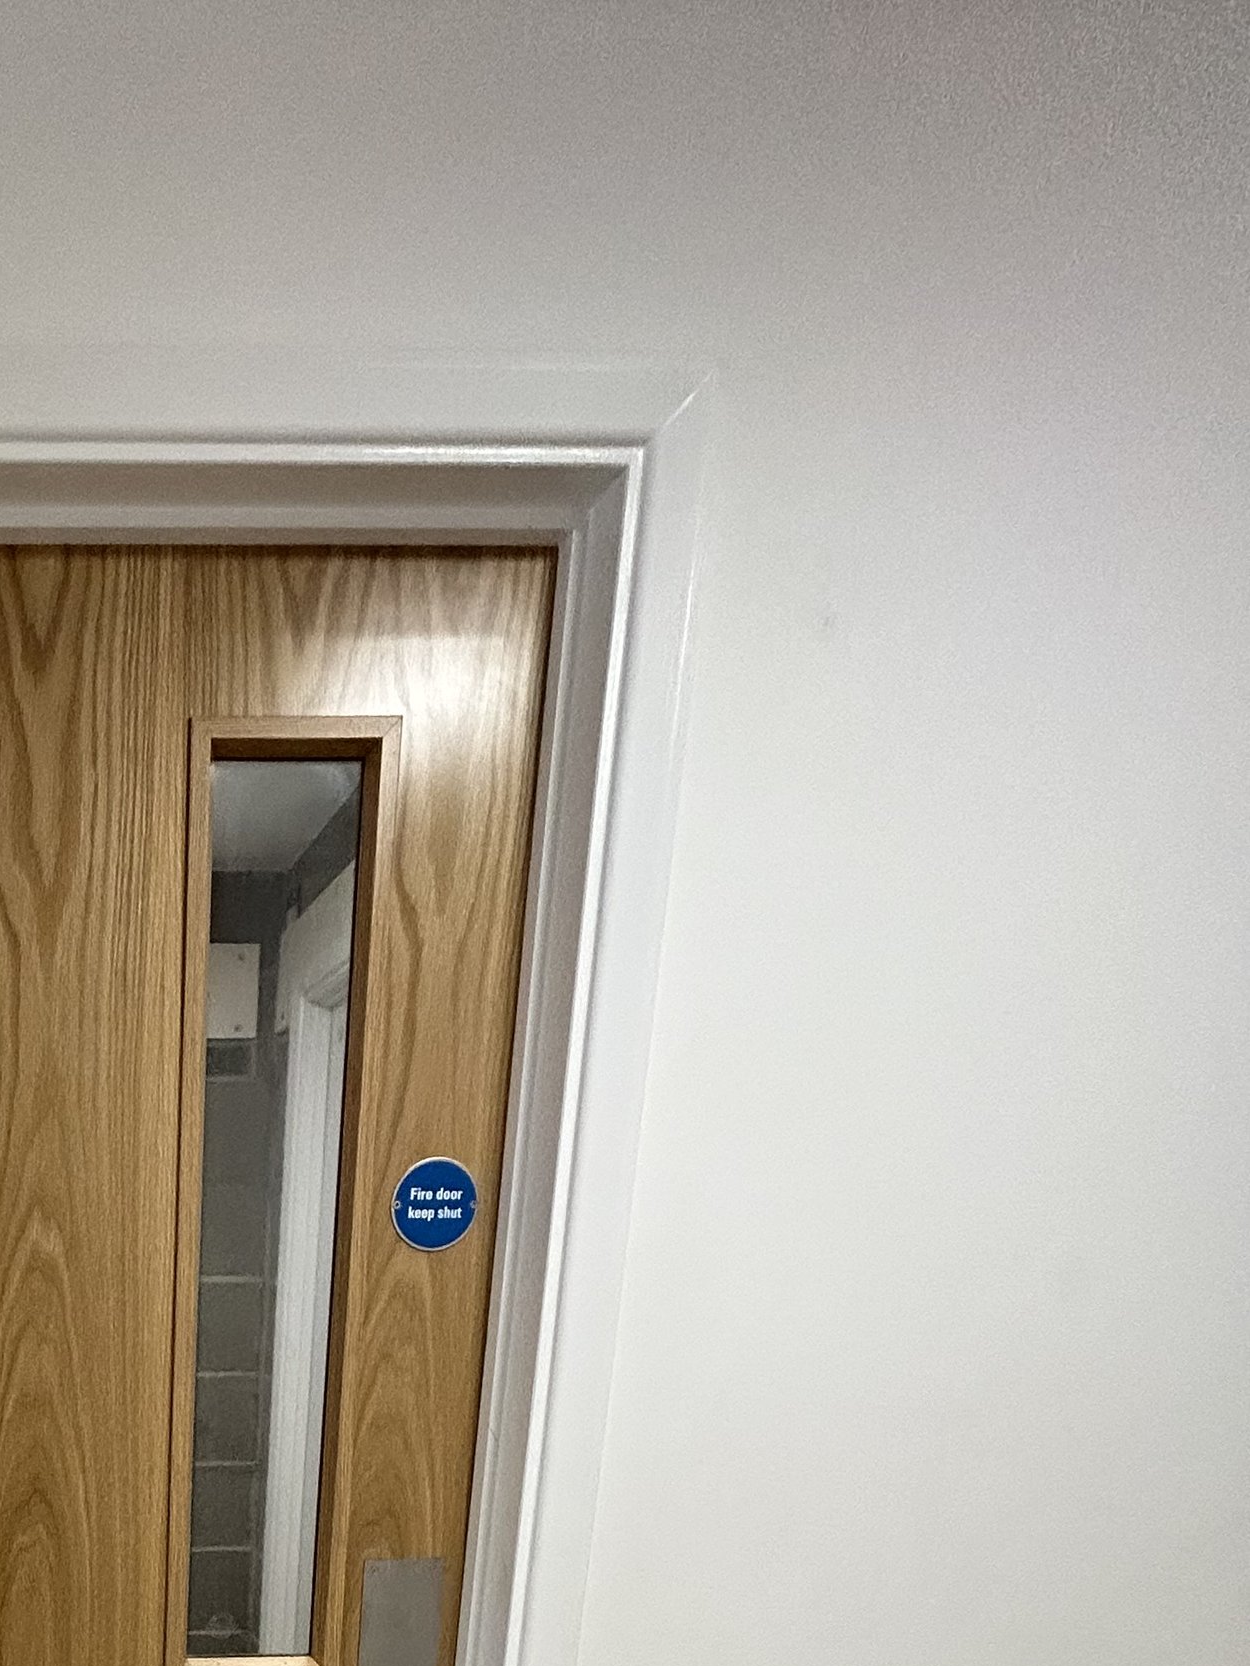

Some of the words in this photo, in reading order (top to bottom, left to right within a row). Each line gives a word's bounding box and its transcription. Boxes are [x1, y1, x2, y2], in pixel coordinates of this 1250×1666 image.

[410, 1188, 433, 1200] Fire
[436, 1187, 463, 1200] door
[408, 1206, 435, 1221] keep
[438, 1206, 462, 1218] shut
